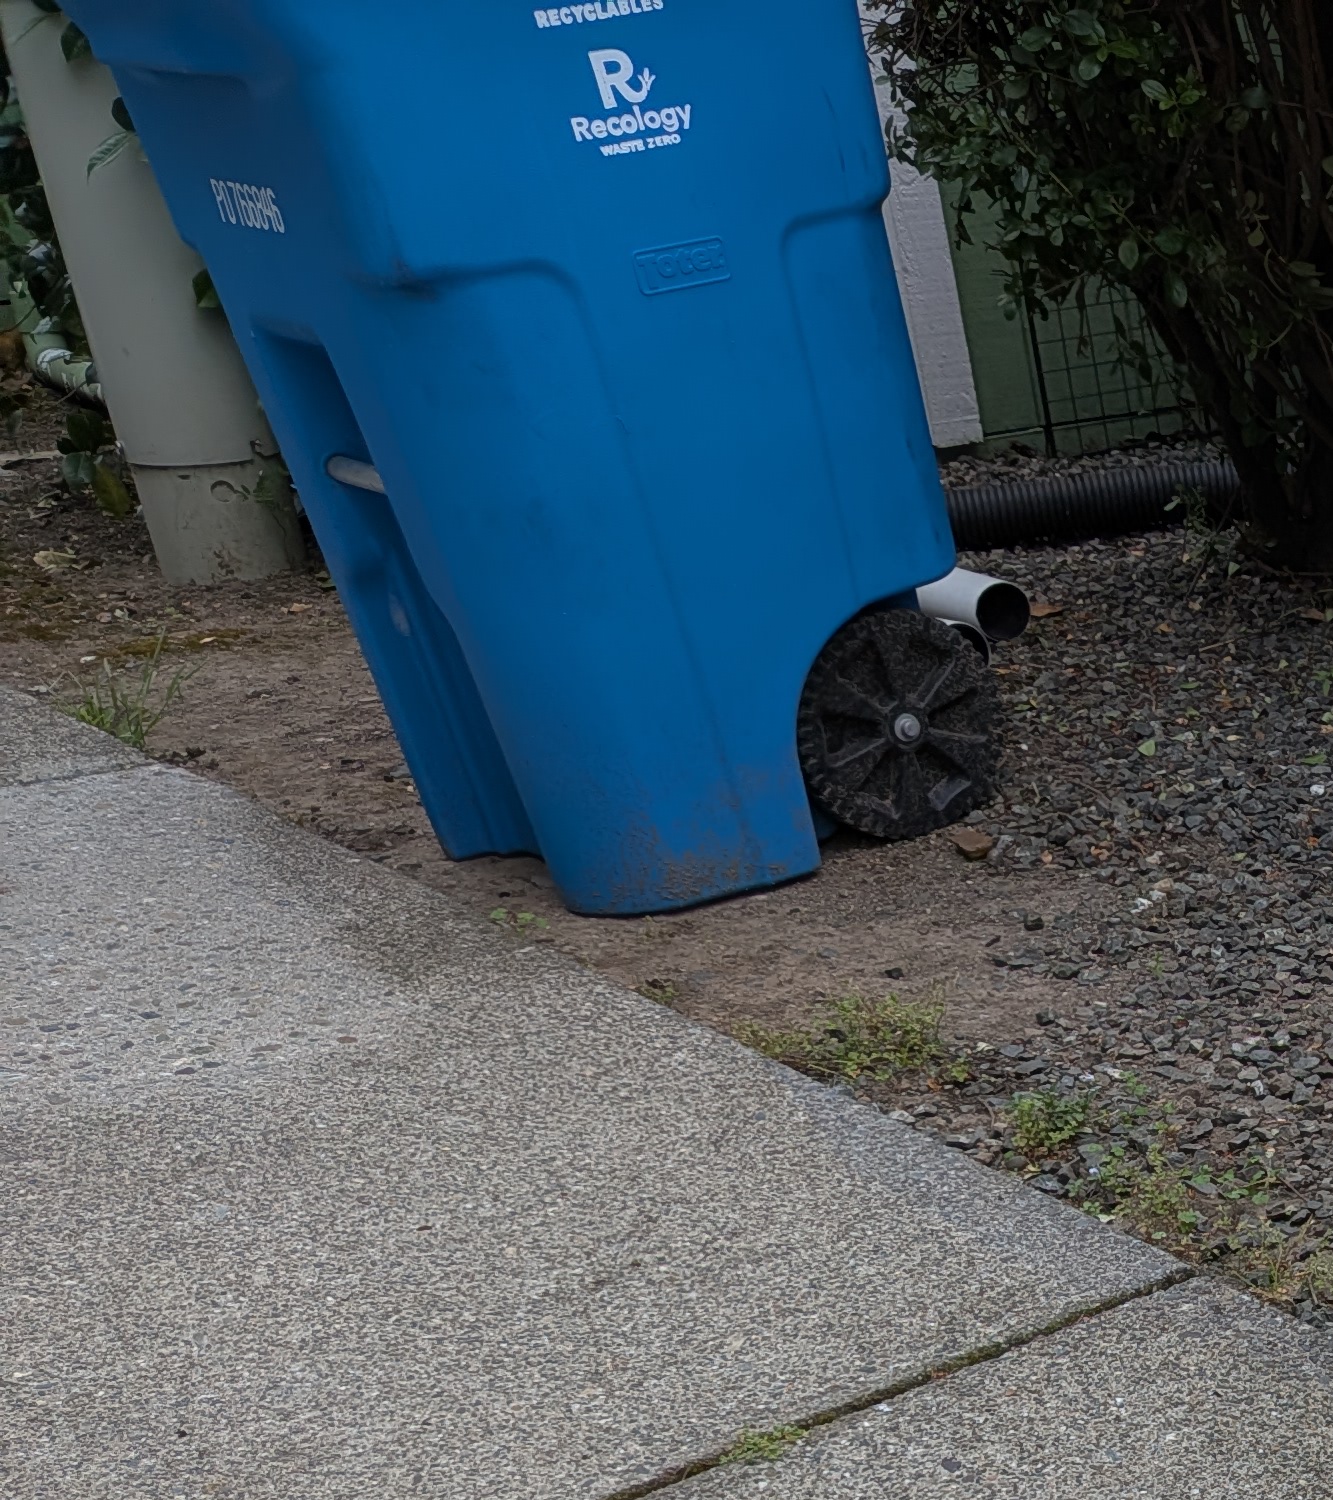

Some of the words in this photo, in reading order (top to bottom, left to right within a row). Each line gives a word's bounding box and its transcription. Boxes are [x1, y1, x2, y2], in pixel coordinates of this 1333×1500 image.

[533, 0, 664, 28] RECYCLABLES
[570, 103, 692, 142] Recology
[600, 139, 645, 156] WASTE
[648, 133, 681, 148] ZERO
